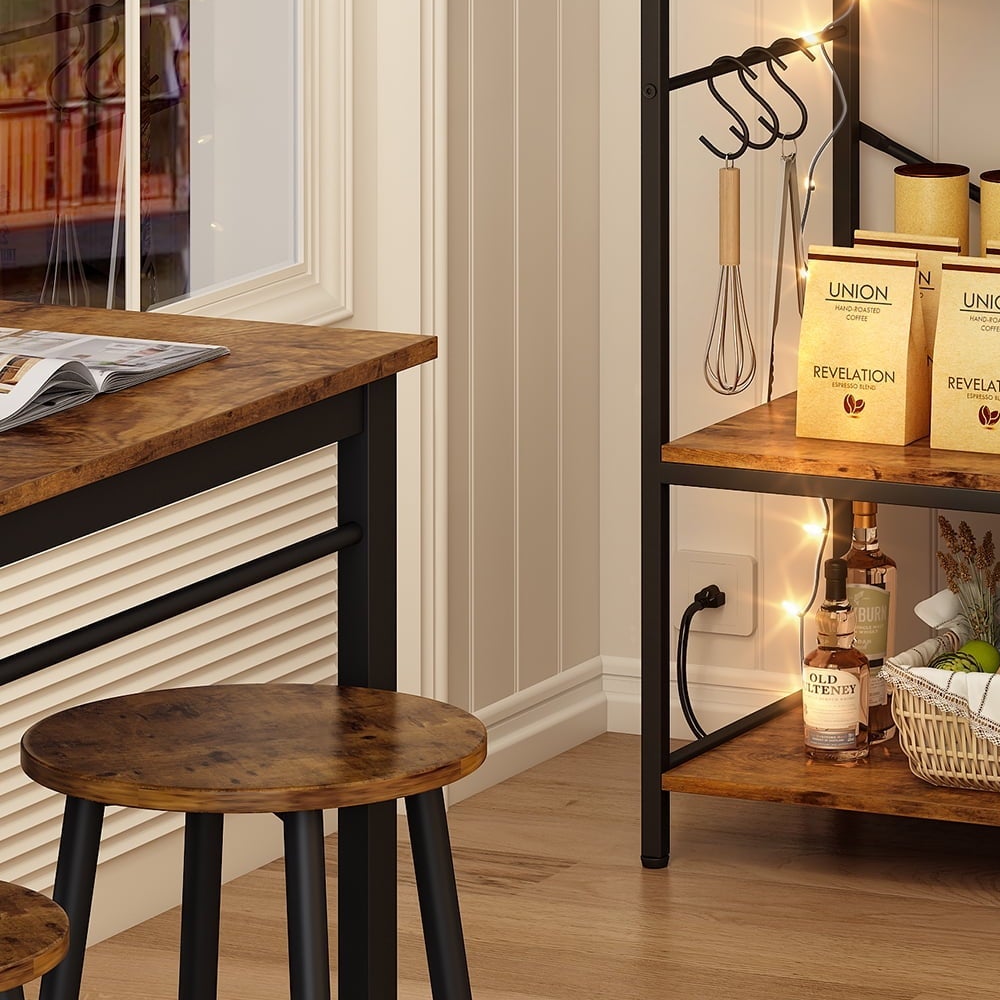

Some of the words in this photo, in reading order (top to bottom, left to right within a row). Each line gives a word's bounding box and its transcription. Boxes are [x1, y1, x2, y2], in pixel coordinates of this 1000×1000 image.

[829, 282, 888, 301] UNION
[835, 305, 881, 314] HAND-ROASTED
[845, 314, 868, 322] COFFEE
[813, 365, 895, 383] REVELATION
[832, 382, 858, 390] ESPRESSO
[966, 393, 994, 401] ESPRESSO
[855, 605, 887, 623] BURN
[809, 672, 838, 685] OLD
[807, 683, 857, 695] LTENEY
